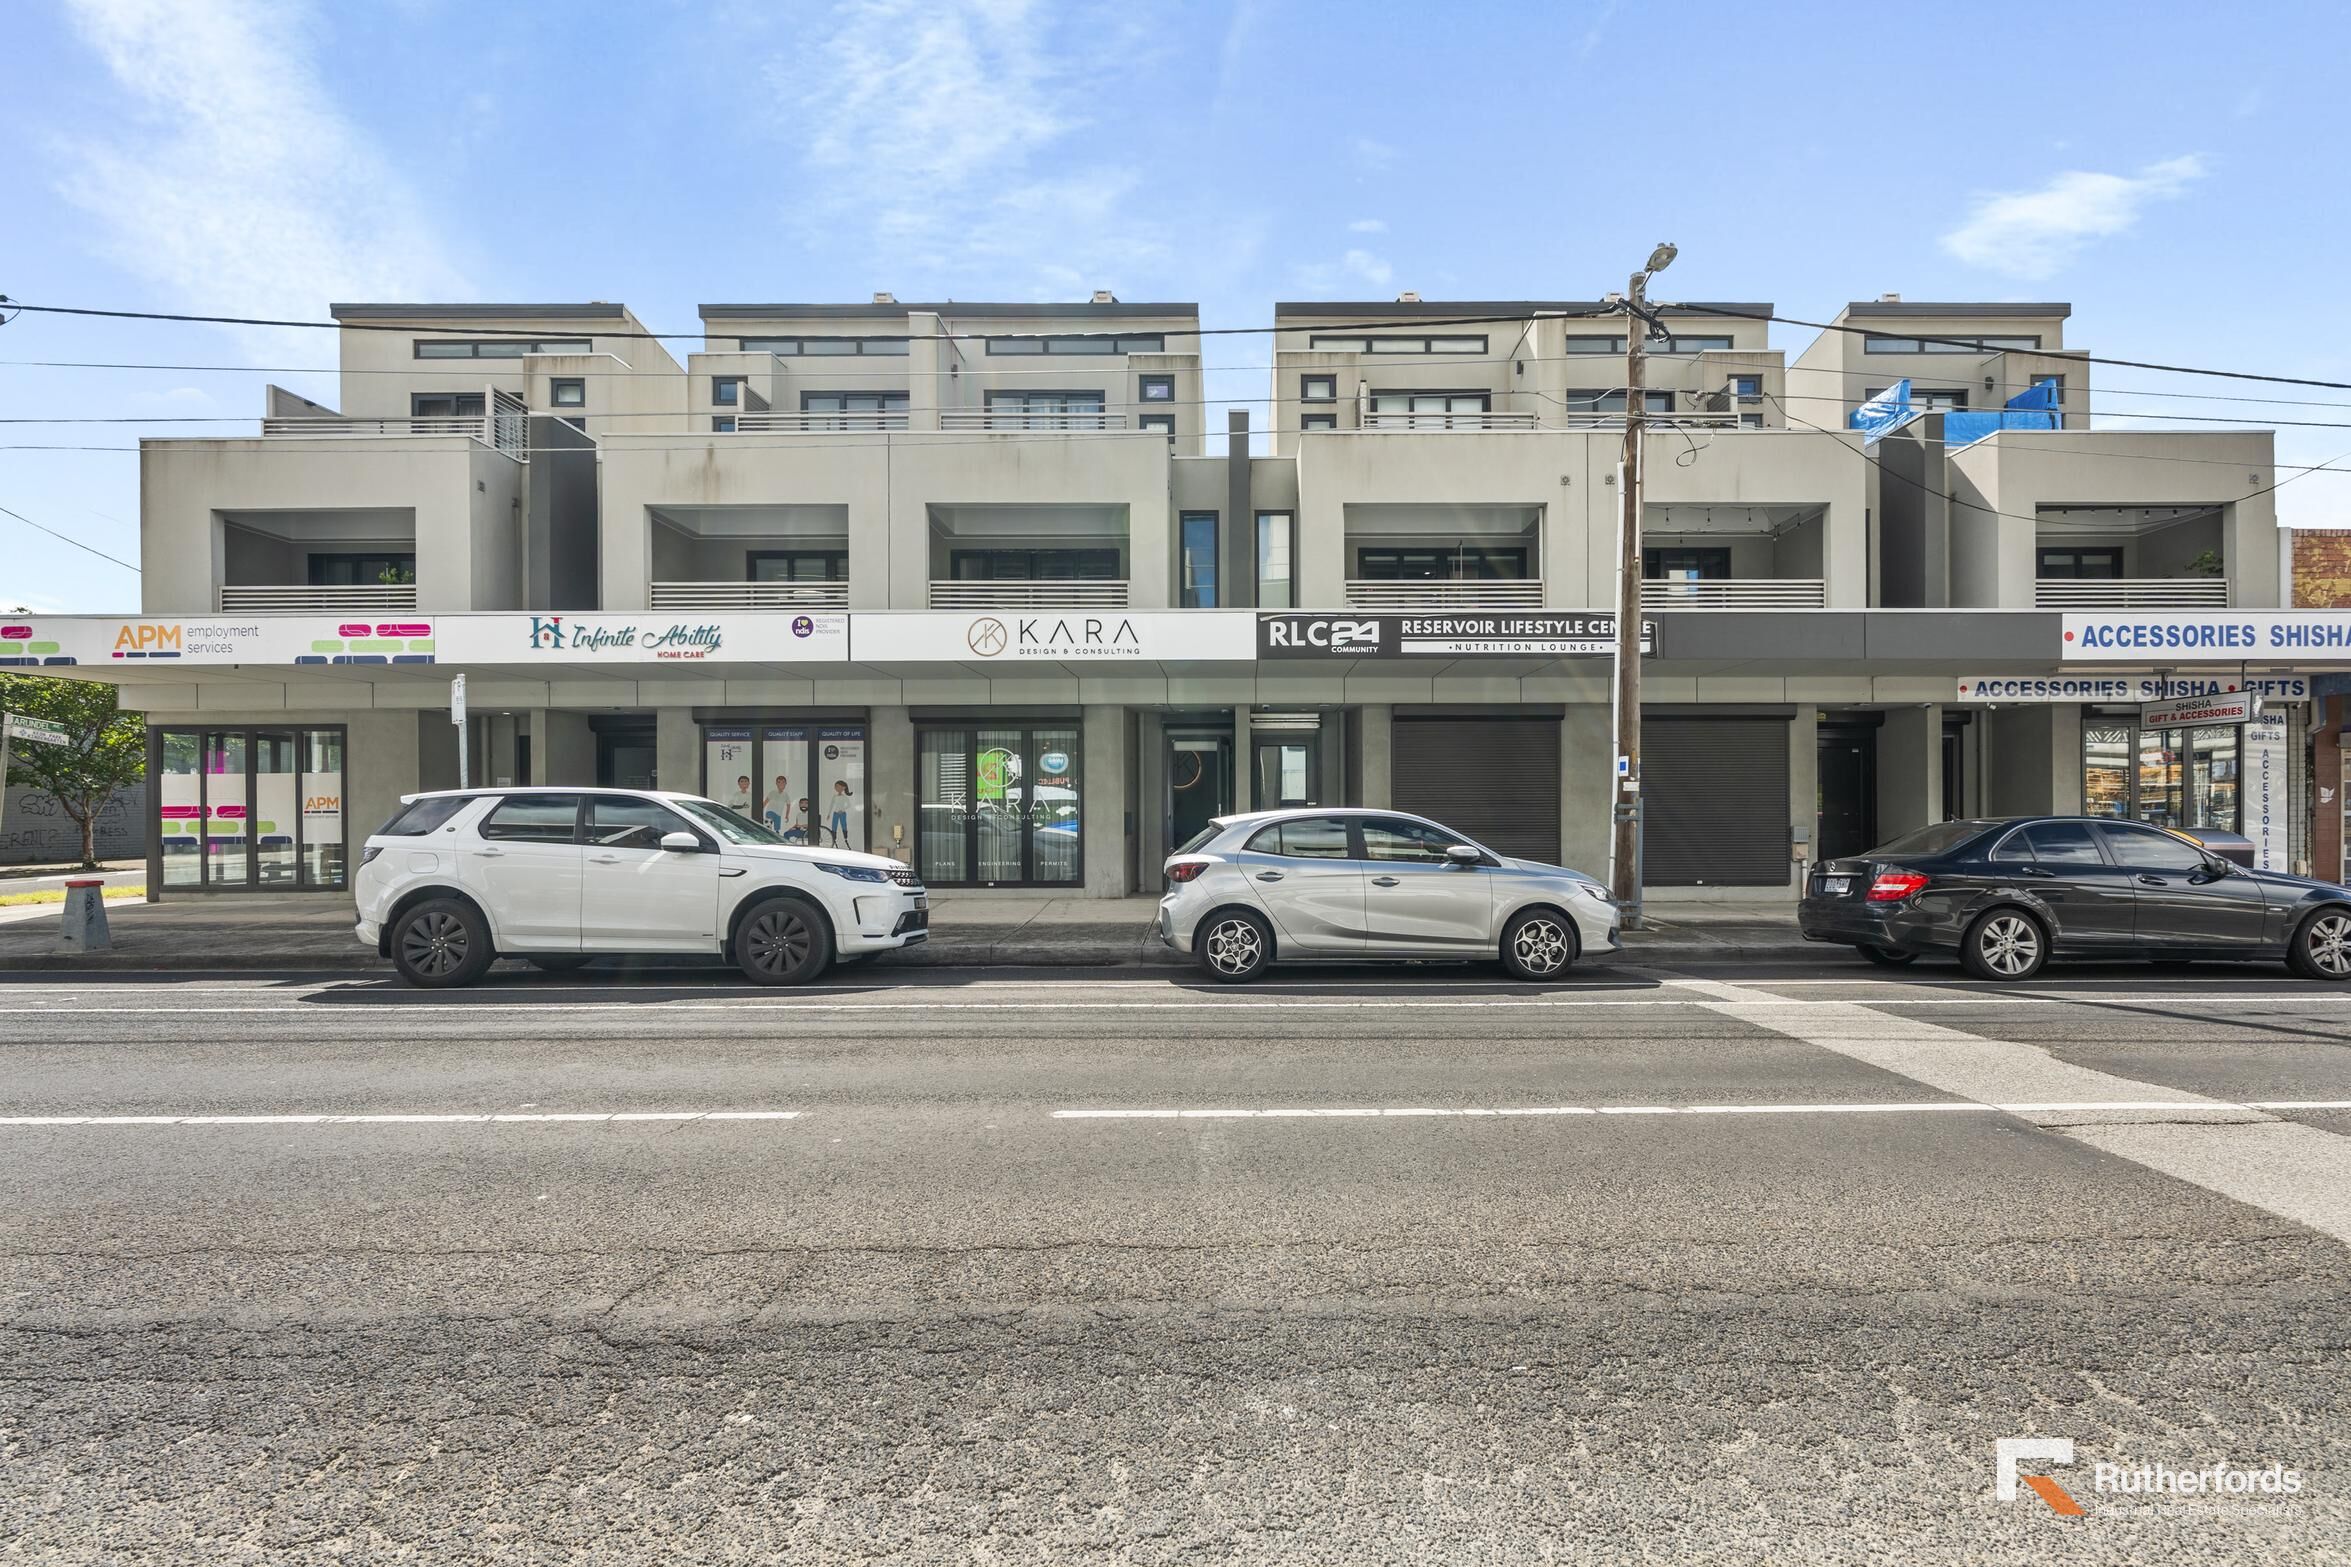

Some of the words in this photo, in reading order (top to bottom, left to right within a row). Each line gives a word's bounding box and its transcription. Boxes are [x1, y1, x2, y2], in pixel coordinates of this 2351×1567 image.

[187, 625, 259, 640] employment
[1019, 619, 1139, 644] KARA
[1269, 621, 1380, 647] RLC24
[1401, 620, 1496, 634] RESERVOIR
[1501, 620, 1583, 634] LIFESTYLE
[1588, 620, 1651, 634] CENE
[114, 625, 182, 650] APM
[571, 624, 637, 652] Infinite
[641, 624, 723, 653] Ability
[2081, 625, 2256, 648] ACCESSORIES
[187, 641, 233, 654] services
[1331, 646, 1379, 654] COMMUNITY
[1455, 643, 1532, 651] NUTRITION
[1541, 643, 1596, 651] LOUNGE
[657, 651, 682, 659] HOME
[683, 651, 705, 659] CARE
[1974, 680, 2129, 697] ACCESSORIES
[2140, 680, 2220, 697] SHISHA
[2175, 699, 2212, 712] SHISHA
[2149, 714, 2168, 724] GIFT
[2170, 713, 2177, 721] &
[2179, 706, 2244, 721] ACCESSORIES
[14, 718, 49, 730] ARUNDEL
[2250, 731, 2281, 741] GIFTS
[305, 796, 339, 809] APM
[951, 792, 1050, 814] KARA
